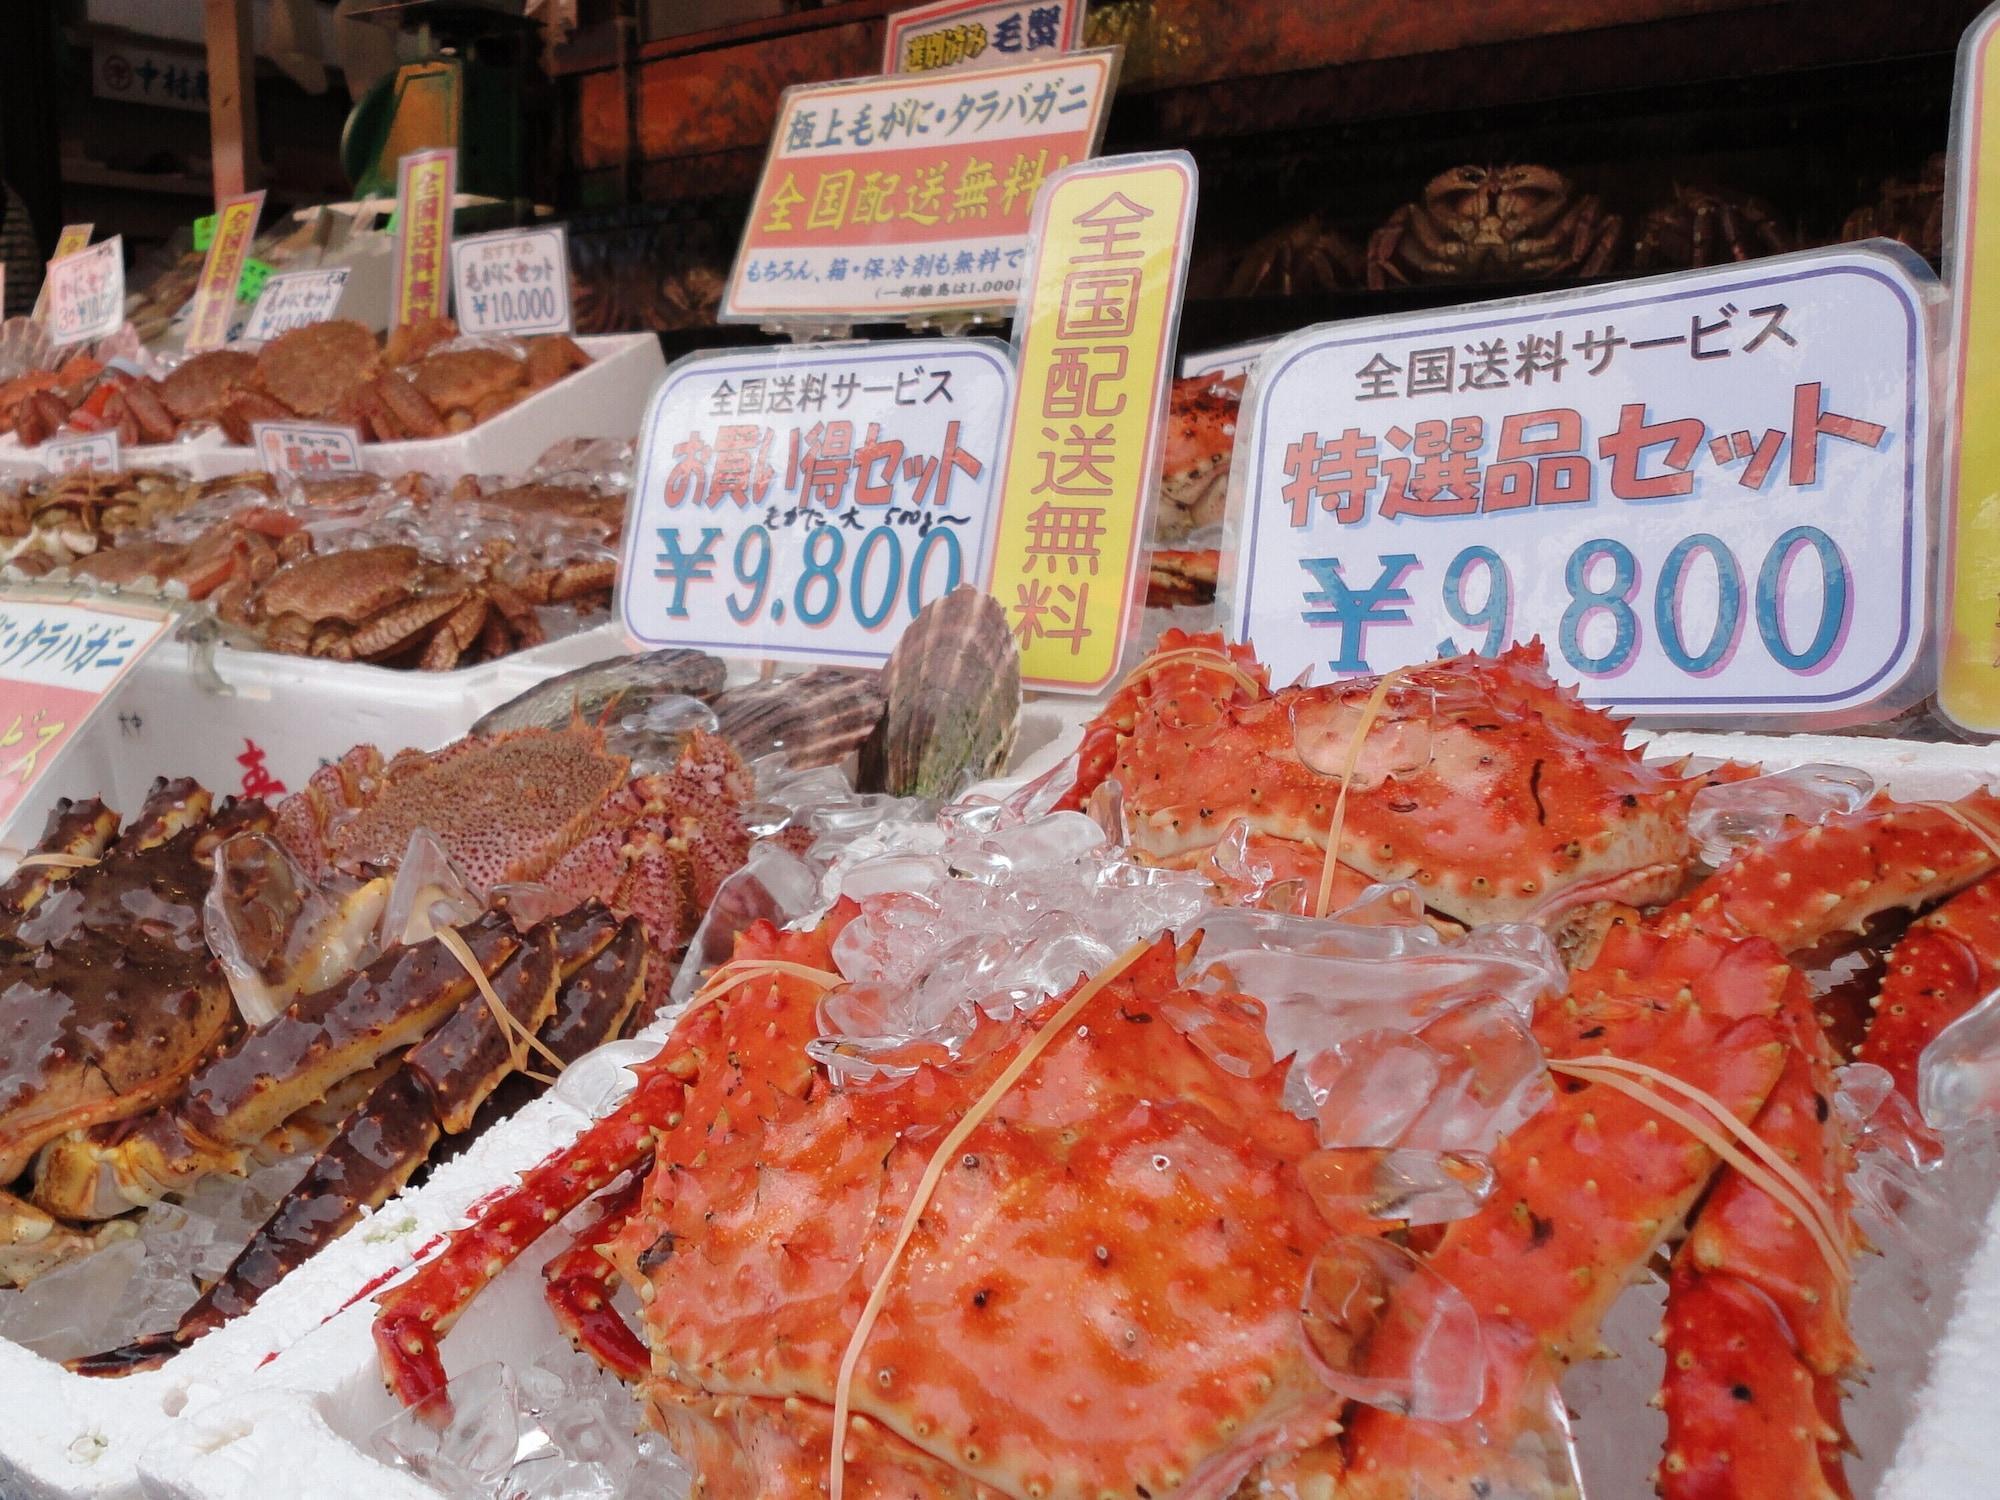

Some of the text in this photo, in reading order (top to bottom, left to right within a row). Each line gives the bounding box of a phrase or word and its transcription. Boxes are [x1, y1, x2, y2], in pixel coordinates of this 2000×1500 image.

[785, 78, 1088, 153] 極上毛がに・タラバガニ
[471, 285, 556, 325] ¥10.000
[1353, 302, 1799, 403] 全国送料サービス
[708, 366, 955, 418] 全国送料サービス
[1011, 190, 1155, 656] 全国配送無料
[664, 419, 983, 511] お買い得セット
[1280, 380, 1889, 530] 特選品セット
[652, 525, 964, 630] ¥9.800
